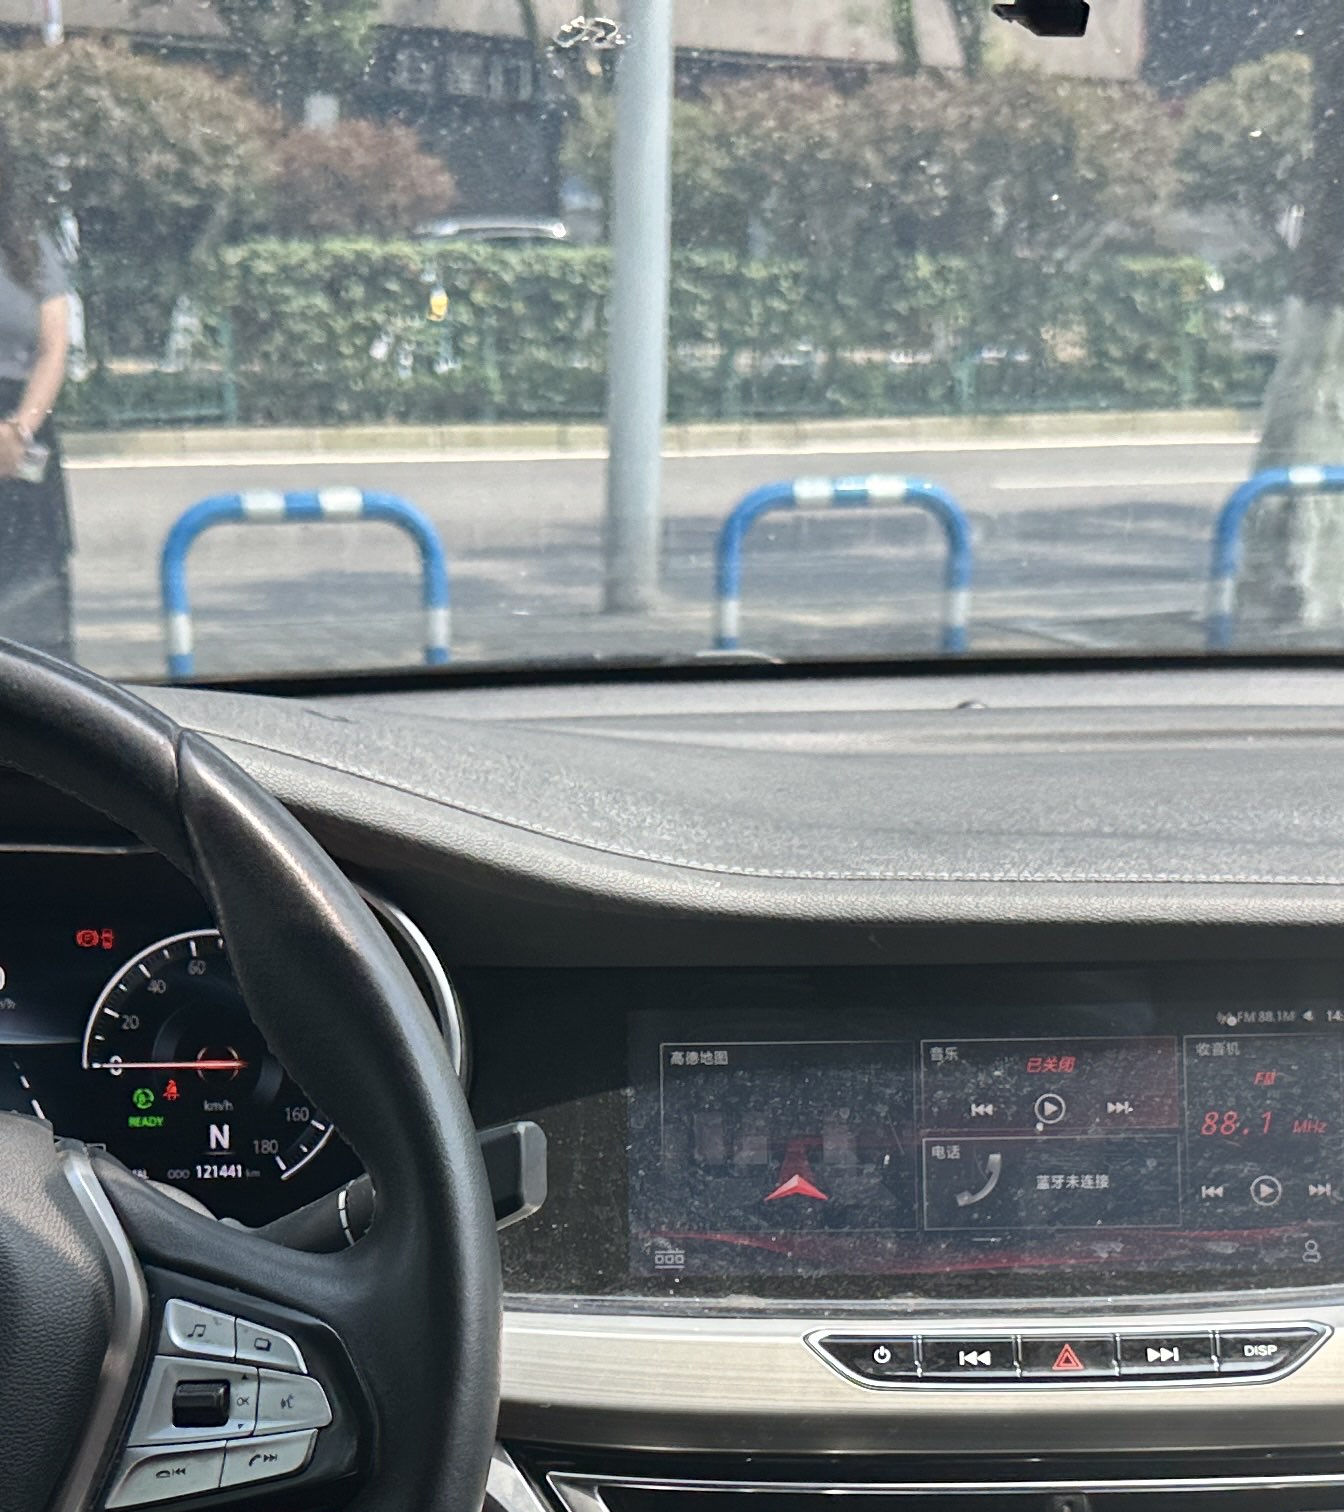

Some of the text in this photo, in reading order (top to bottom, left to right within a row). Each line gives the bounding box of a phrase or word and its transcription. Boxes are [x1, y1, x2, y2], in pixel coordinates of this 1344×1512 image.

[187, 960, 206, 975] 60
[147, 978, 167, 993] 40
[122, 1015, 140, 1030] 20
[1236, 1011, 1256, 1023] FM
[929, 1046, 959, 1062] 音乐
[1196, 1041, 1240, 1057] 收音机
[670, 1050, 729, 1066] 高德地图
[1026, 1056, 1077, 1073] 已关闭
[1254, 1071, 1277, 1086] FM
[203, 1100, 234, 1112] km/h
[128, 1116, 164, 1128] READY
[285, 1107, 310, 1122] 160
[1201, 1111, 1328, 1136] 88.1 MHz
[209, 1123, 231, 1150] N
[253, 1139, 279, 1154] 180
[931, 1144, 961, 1160] 电话
[167, 1164, 262, 1180] ODO 121441 km
[1036, 1174, 1110, 1190] 蓝牙未连接
[1243, 1344, 1278, 1357] DISP
